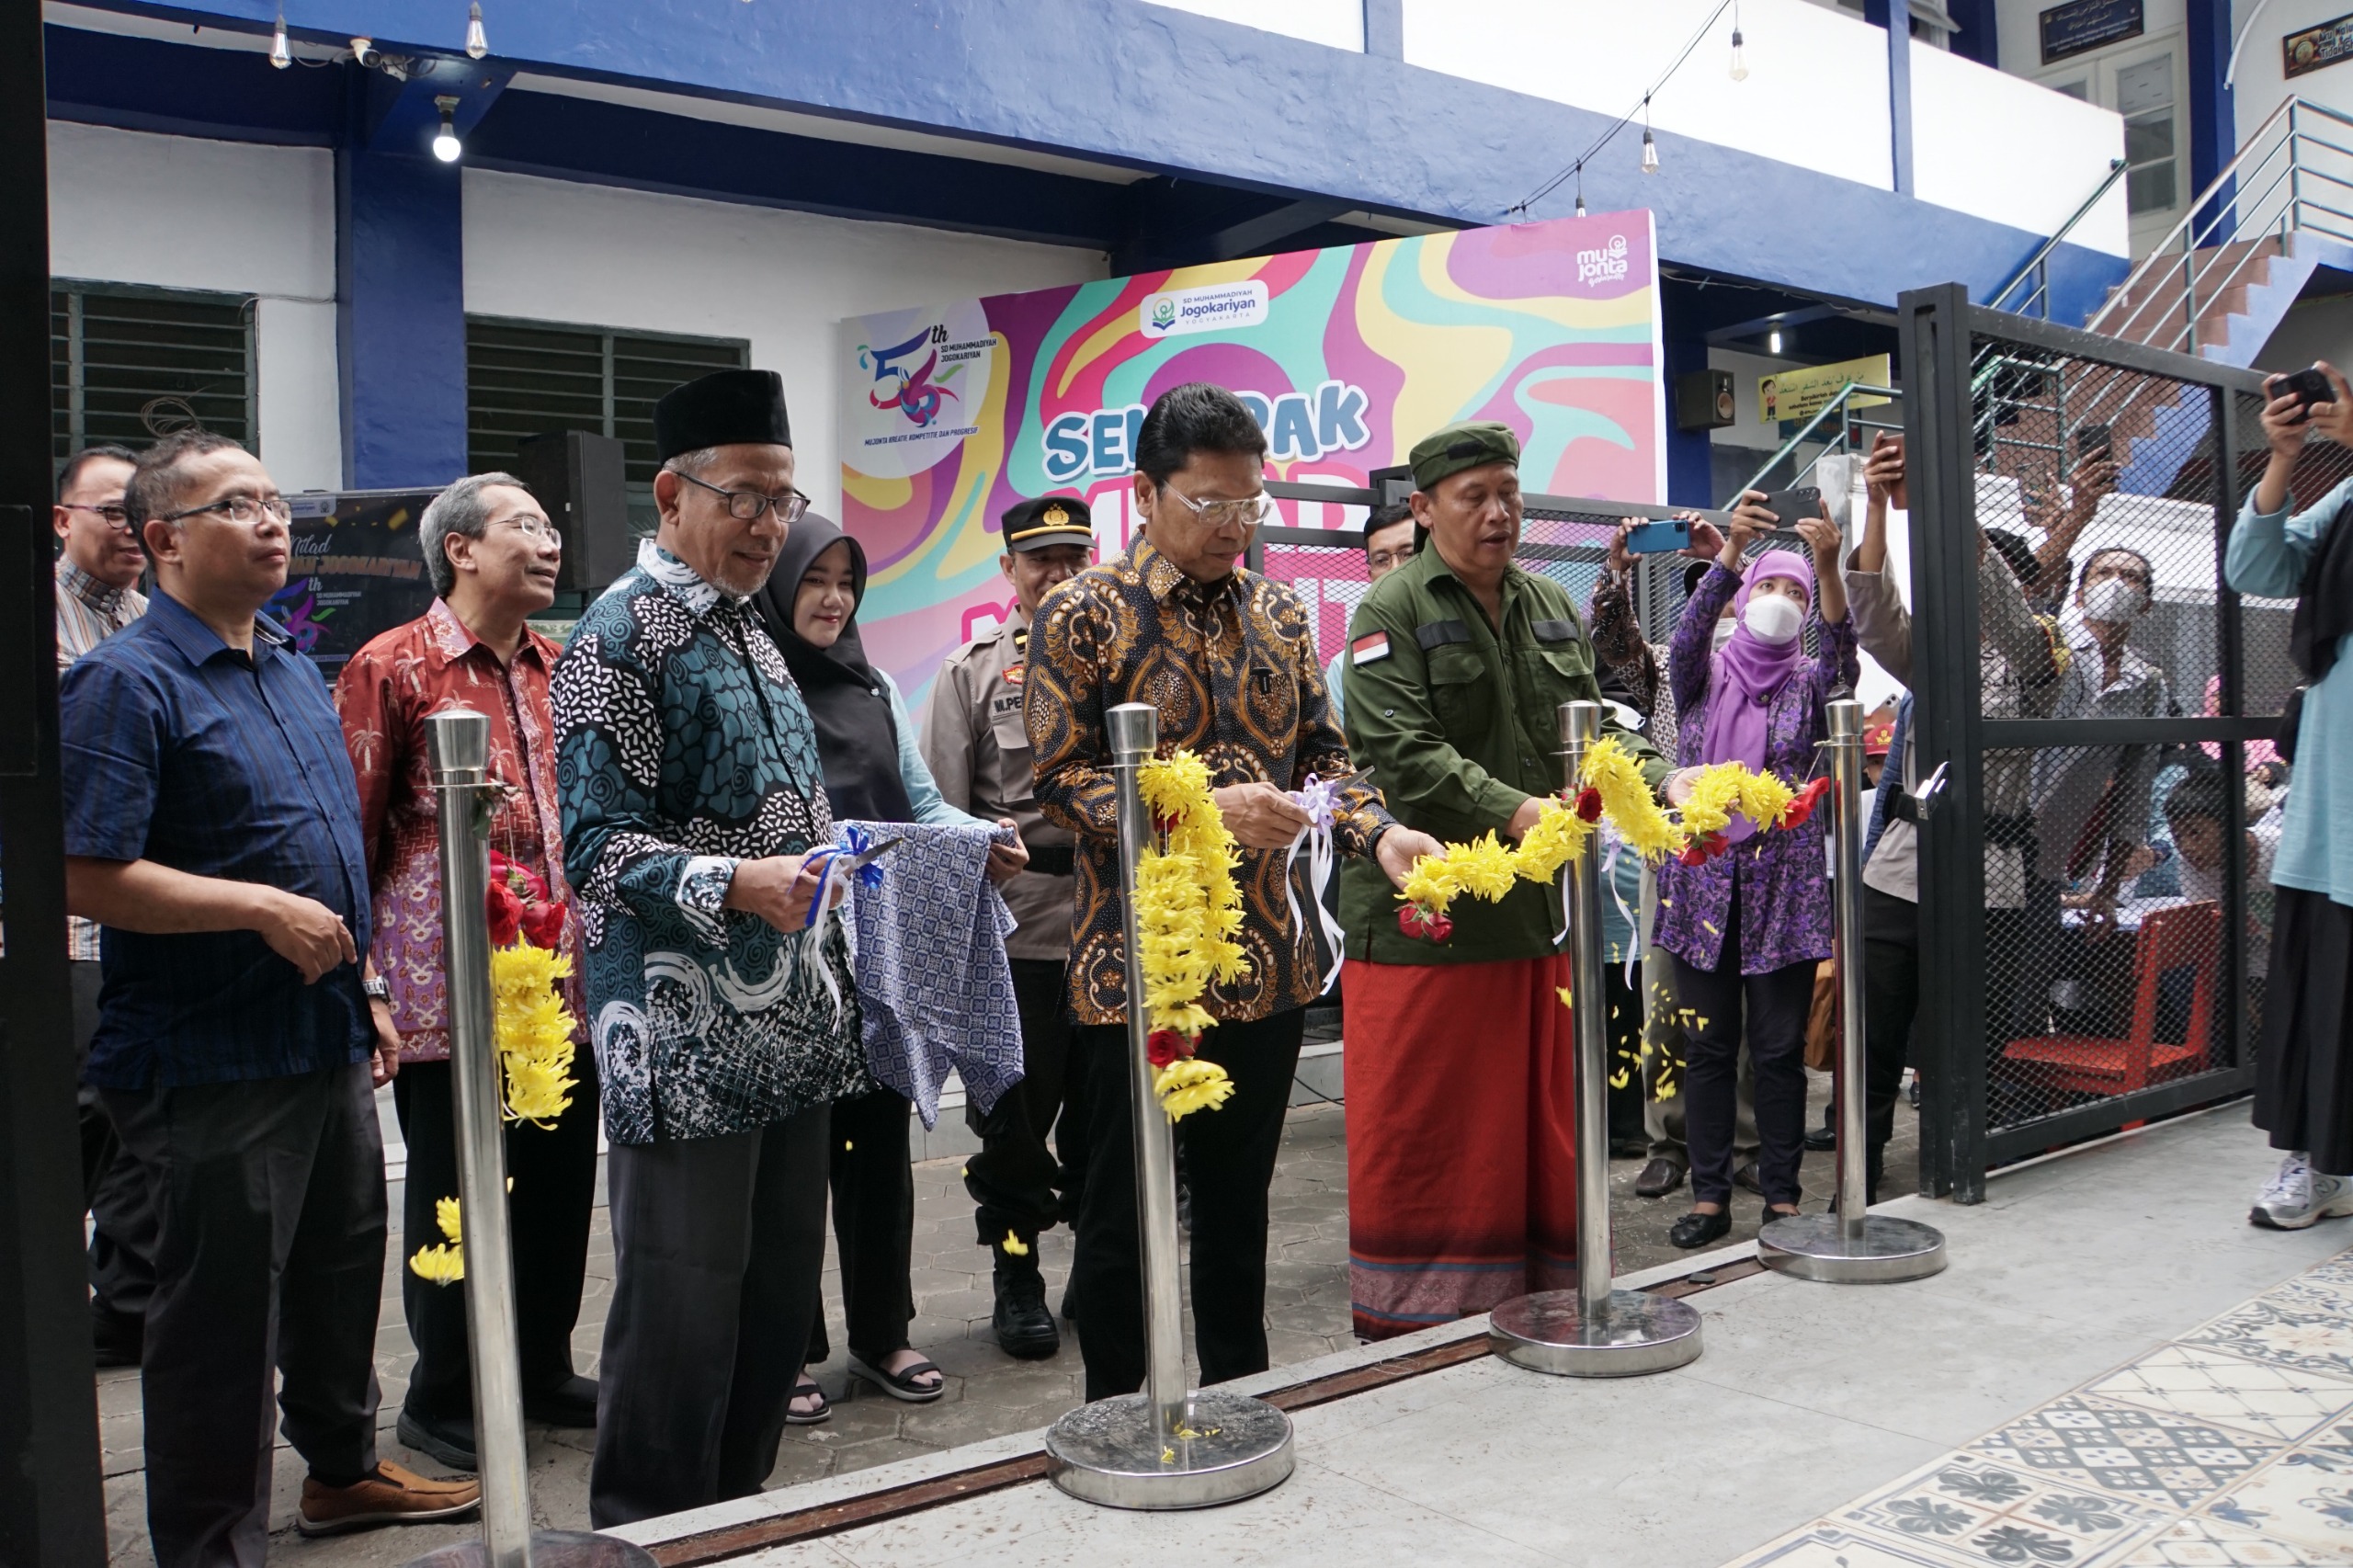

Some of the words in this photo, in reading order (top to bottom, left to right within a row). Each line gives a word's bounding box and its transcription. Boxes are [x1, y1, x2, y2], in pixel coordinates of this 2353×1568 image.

[1576, 248, 1608, 265] mu
[1194, 290, 1253, 302] MUHAMMADIYAH
[1180, 299, 1256, 318] Jogokariyan
[1185, 312, 1251, 325] YOGYAKARTA
[940, 345, 949, 353] SD
[949, 338, 997, 352] MUHAMMADIYAH
[940, 350, 981, 363] JOGOKARIYAN
[864, 437, 888, 447] MUJONTA
[938, 430, 950, 438] DAN
[949, 426, 979, 437] PROGRESIF
